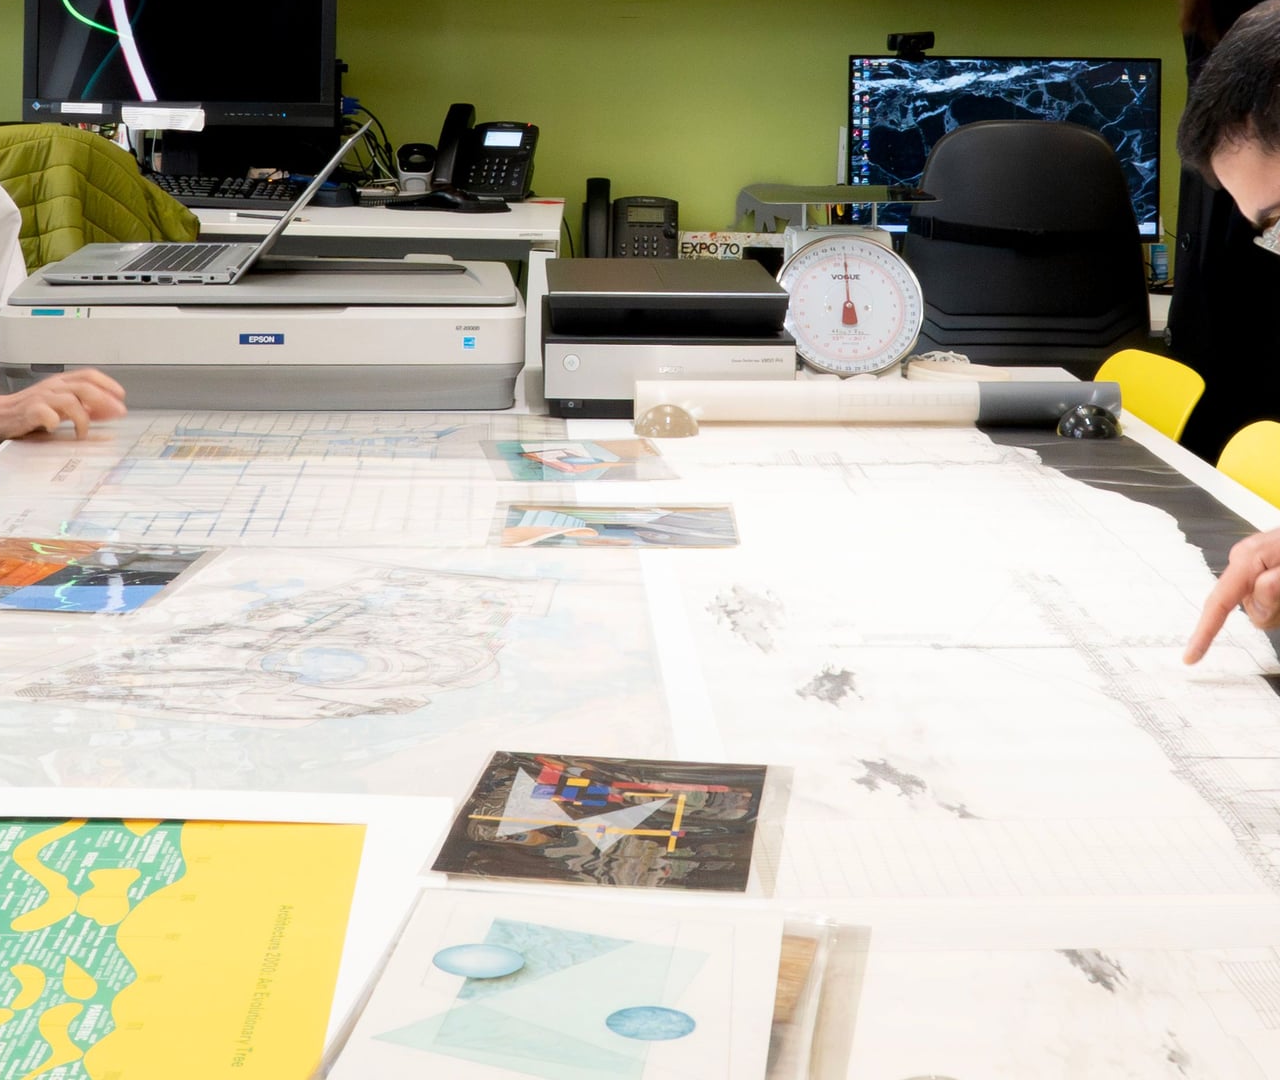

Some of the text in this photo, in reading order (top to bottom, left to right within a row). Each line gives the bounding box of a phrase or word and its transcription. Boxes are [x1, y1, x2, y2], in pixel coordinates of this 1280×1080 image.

[248, 334, 276, 344] EPSON
[268, 904, 294, 951] Architecture
[235, 990, 271, 1046] Evolutionary
[231, 1046, 254, 1068] Tree
